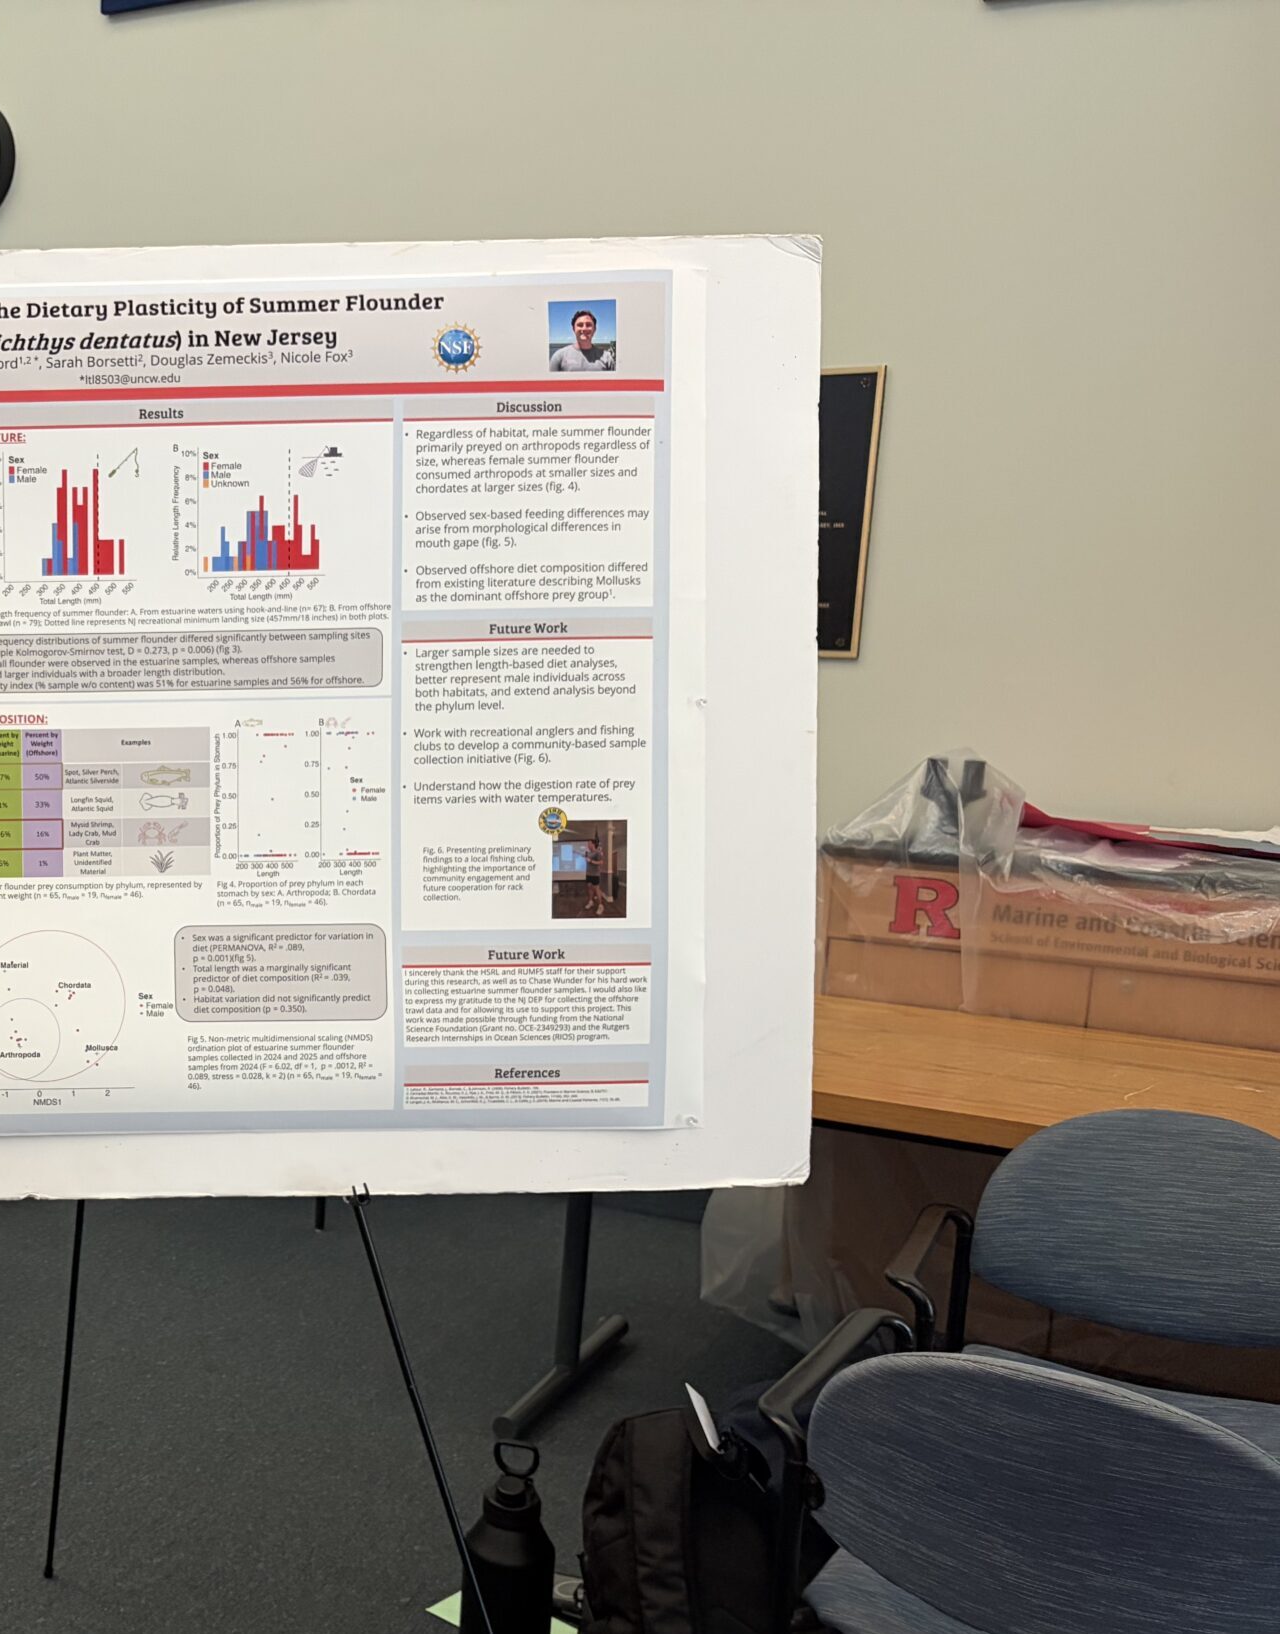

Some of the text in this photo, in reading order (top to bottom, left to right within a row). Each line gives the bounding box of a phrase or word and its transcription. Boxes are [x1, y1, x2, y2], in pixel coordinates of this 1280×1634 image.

[26, 302, 107, 321] Dietary
[113, 298, 217, 318] Plasticity
[222, 297, 245, 314] of
[249, 298, 340, 313] Summer
[345, 293, 444, 311] Flounder
[79, 331, 181, 350] dentatus)
[187, 330, 209, 347] in
[214, 330, 262, 347] New
[266, 329, 337, 349] Jersey
[439, 339, 476, 355] NSF
[45, 352, 83, 369] Sarah
[150, 354, 203, 369] Douglas
[280, 351, 321, 363] Nicole
[496, 401, 562, 413] Discussion
[138, 407, 184, 419] Results
[416, 426, 652, 441] Regardless of habitat, male summer flounder
[8, 455, 25, 464] Sex
[202, 451, 219, 460] Sex
[16, 466, 47, 475] Female
[210, 462, 242, 471] Female
[16, 475, 37, 483] Male
[210, 470, 231, 479] Male
[210, 479, 250, 488] Unknown
[415, 561, 648, 575] Observed offshore diet composition differed
[39, 597, 102, 606] Total Length (mm)
[489, 622, 568, 634] Future Work
[121, 738, 151, 747] Examples
[413, 778, 635, 792] Understand how the digestion rate of prey
[422, 883, 523, 892] future cooperation for rack
[889, 875, 961, 939] R
[992, 904, 1117, 934] Marine and
[488, 948, 565, 960] Future Work
[1053, 937, 1252, 969] Environmental and Biological
[58, 981, 92, 990] Chordata
[0, 1050, 41, 1060] Arthropoda
[494, 1067, 560, 1078] References
[32, 1098, 62, 1106] NMDS1
